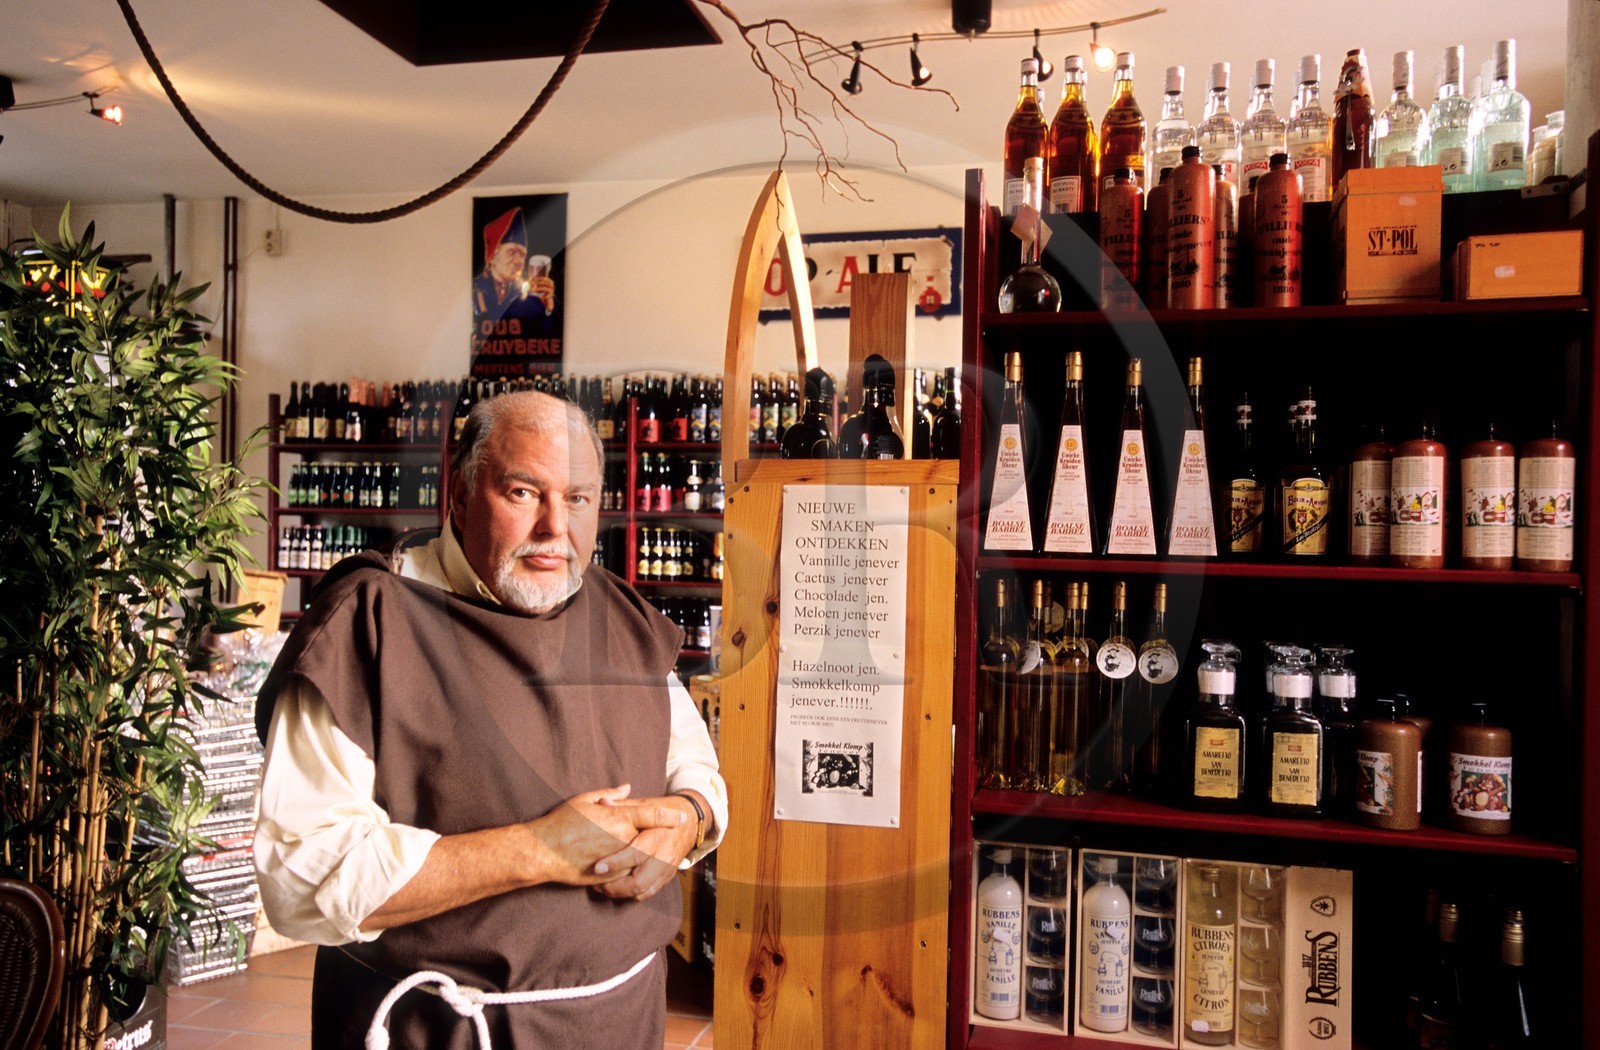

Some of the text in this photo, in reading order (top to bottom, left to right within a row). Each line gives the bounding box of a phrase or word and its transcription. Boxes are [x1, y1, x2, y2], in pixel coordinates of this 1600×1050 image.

[1281, 194, 1288, 204] 5
[797, 502, 856, 515] NIEUWE
[811, 519, 875, 533] SMAKEN
[795, 537, 889, 550] ONTDEKKEN
[799, 554, 900, 571] Vannille jenever
[794, 571, 889, 587] Cactus jenever
[794, 589, 889, 605] Chocolade jen.
[794, 606, 889, 622] Meloen jenever
[794, 623, 881, 640] Perzik jenever
[792, 660, 880, 677] Hazelnoot jen.
[791, 677, 880, 695] Smokkelkomp
[814, 741, 864, 751] Smokkel Klomp
[1202, 751, 1232, 760] AMARETTO
[1280, 757, 1310, 765] AMARETTO
[1458, 757, 1492, 768] Smokkel
[1201, 768, 1232, 777] BENEDETTO
[1279, 774, 1310, 783] BENEDETTO
[982, 908, 1020, 919] RUBBENS
[986, 921, 1017, 930] VANILLE
[1191, 926, 1234, 941] RUBBENS
[986, 973, 1016, 984] VANILLE
[1095, 984, 1126, 996] VANILLE
[1193, 993, 1230, 1010] CITRON
